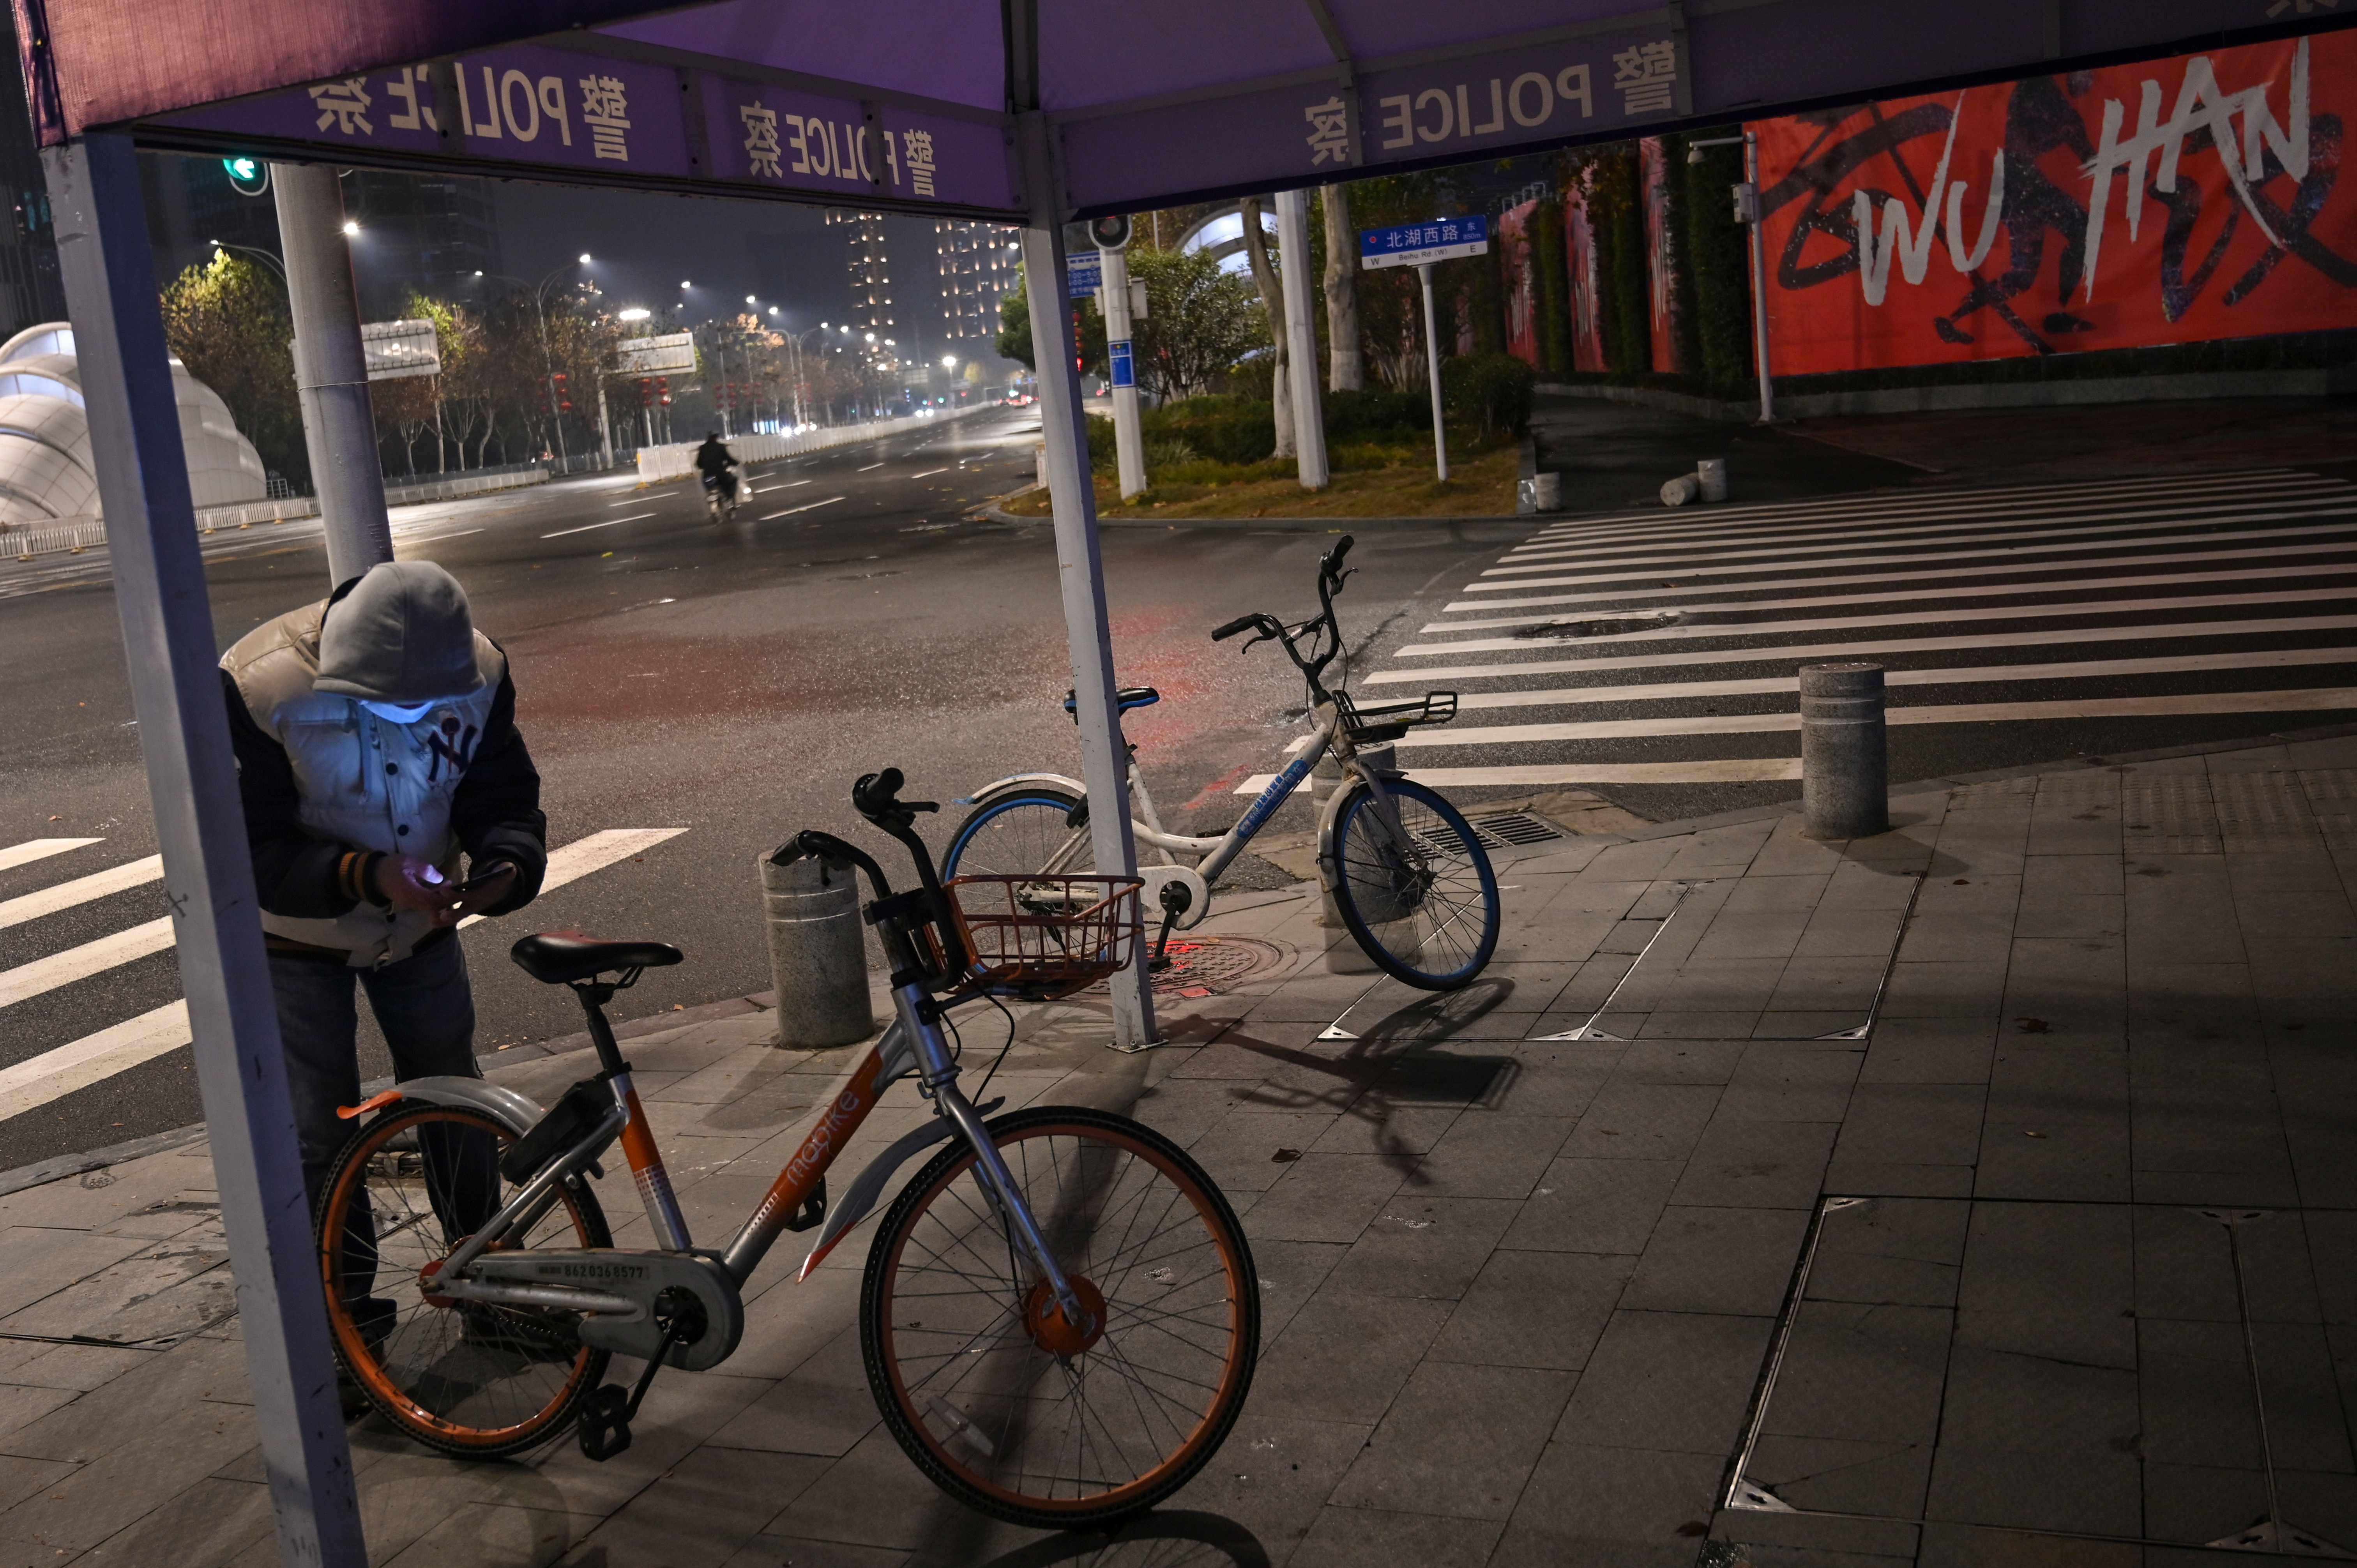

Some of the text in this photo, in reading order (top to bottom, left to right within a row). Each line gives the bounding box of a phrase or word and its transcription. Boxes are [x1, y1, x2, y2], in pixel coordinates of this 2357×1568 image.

[1852, 36, 2311, 307] WU HAN
[1387, 224, 1459, 248] 北湖西路
[1467, 222, 1475, 231] 东
